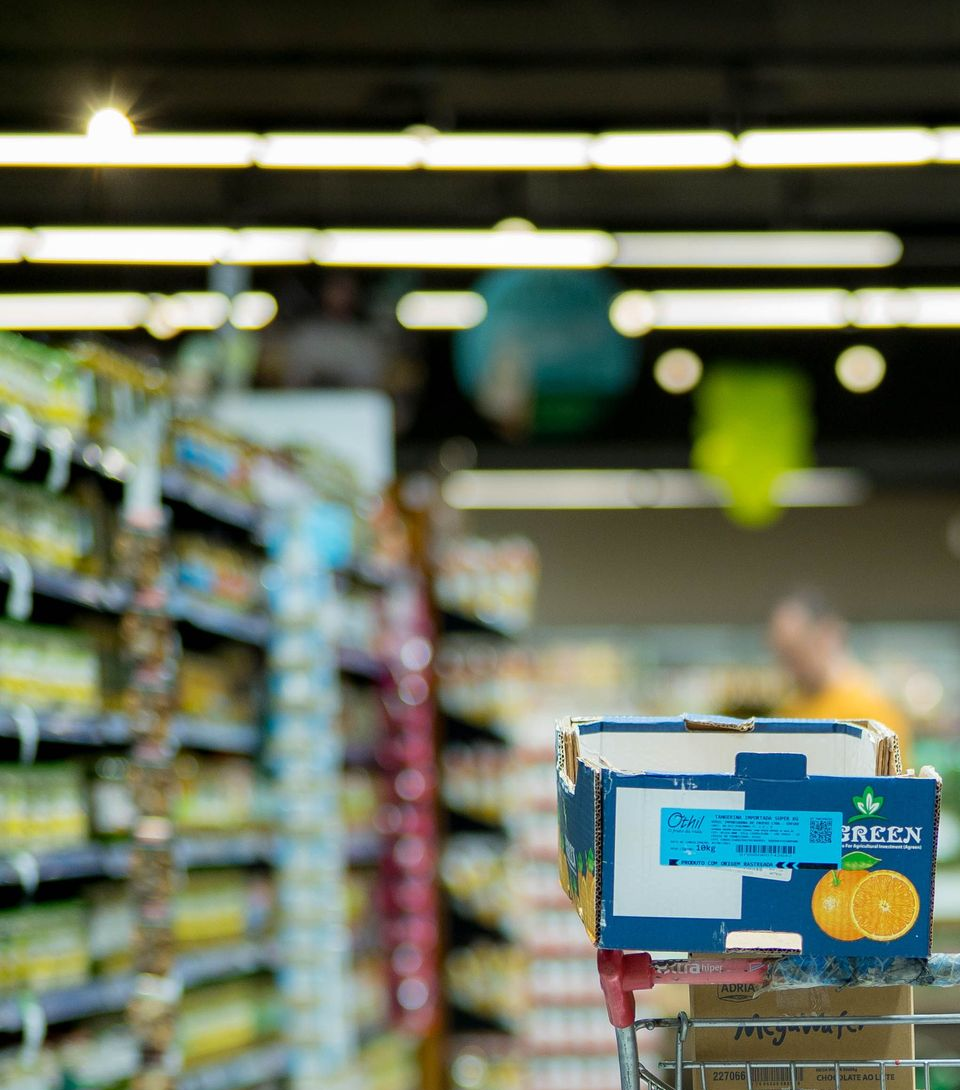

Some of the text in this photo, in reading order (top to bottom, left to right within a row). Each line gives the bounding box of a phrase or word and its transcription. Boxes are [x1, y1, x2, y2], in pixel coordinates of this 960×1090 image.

[668, 812, 705, 829] Othil
[696, 844, 717, 853] 10kg
[721, 983, 756, 994] ADRIA
[713, 1071, 746, 1081] 227066
[862, 1073, 874, 1081] AO
